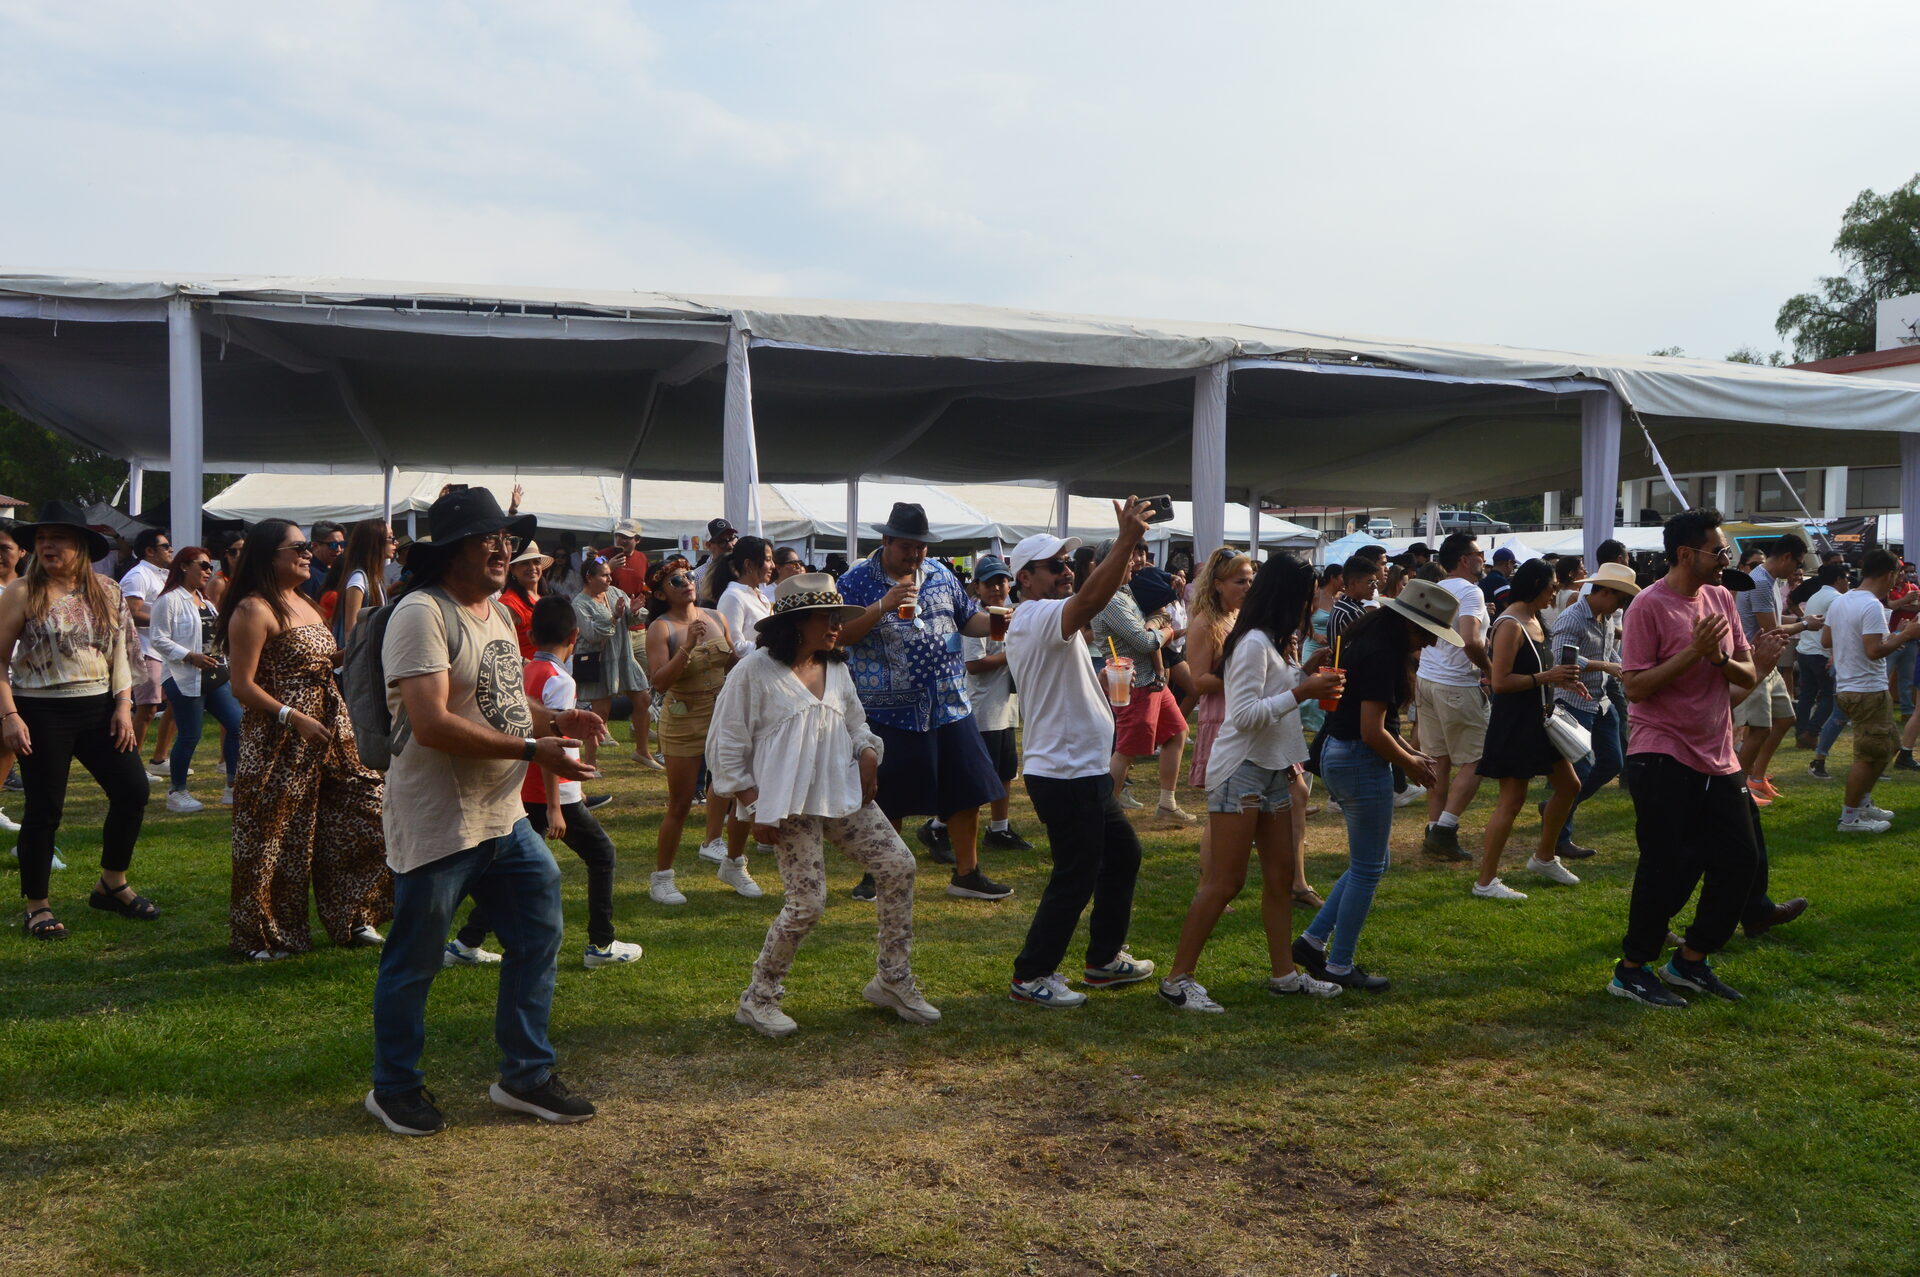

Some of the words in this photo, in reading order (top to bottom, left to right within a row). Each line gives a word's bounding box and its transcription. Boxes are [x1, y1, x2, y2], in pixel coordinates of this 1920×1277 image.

[482, 643, 498, 669] FIRST
[479, 670, 498, 718] STRIKE
[504, 722, 521, 737] NO
